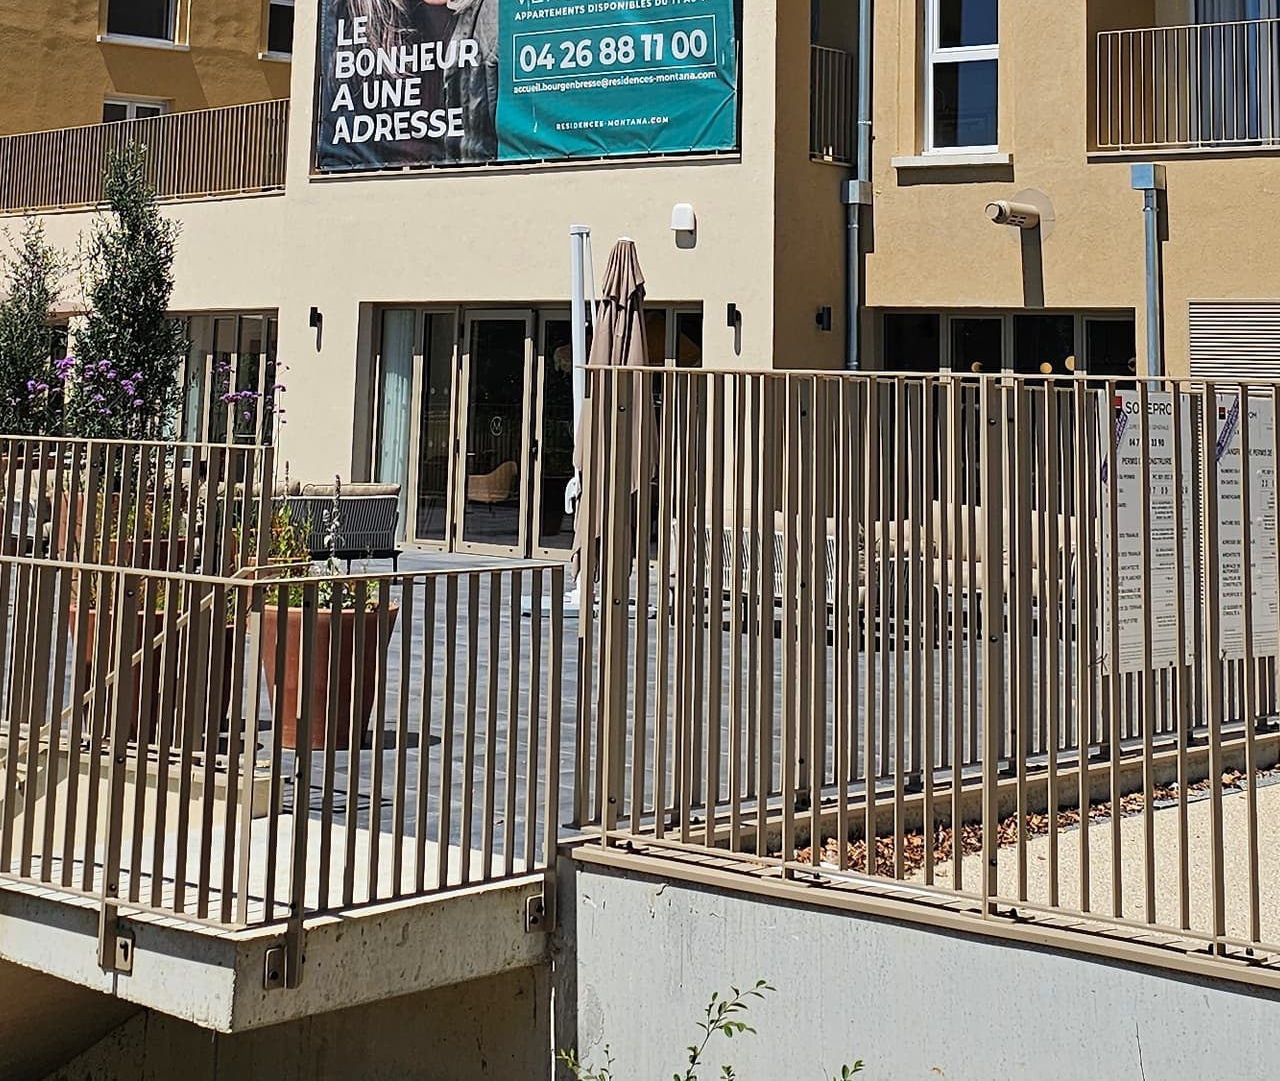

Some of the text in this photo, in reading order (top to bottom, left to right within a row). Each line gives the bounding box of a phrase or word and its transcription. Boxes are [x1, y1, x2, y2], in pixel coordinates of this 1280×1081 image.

[514, 6, 585, 21] APPARTEMENTS
[588, 0, 652, 13] DISPONIBLES
[337, 16, 368, 47] LE
[335, 39, 480, 79] BONHEUR
[519, 29, 708, 72] 04 26 88 11 00
[330, 77, 422, 112] A UNE
[513, 71, 717, 94] accueil.bourgenbresse@residences-montana.com
[331, 107, 465, 145] ADRESSE
[1125, 401, 1173, 416] SOEPRO
